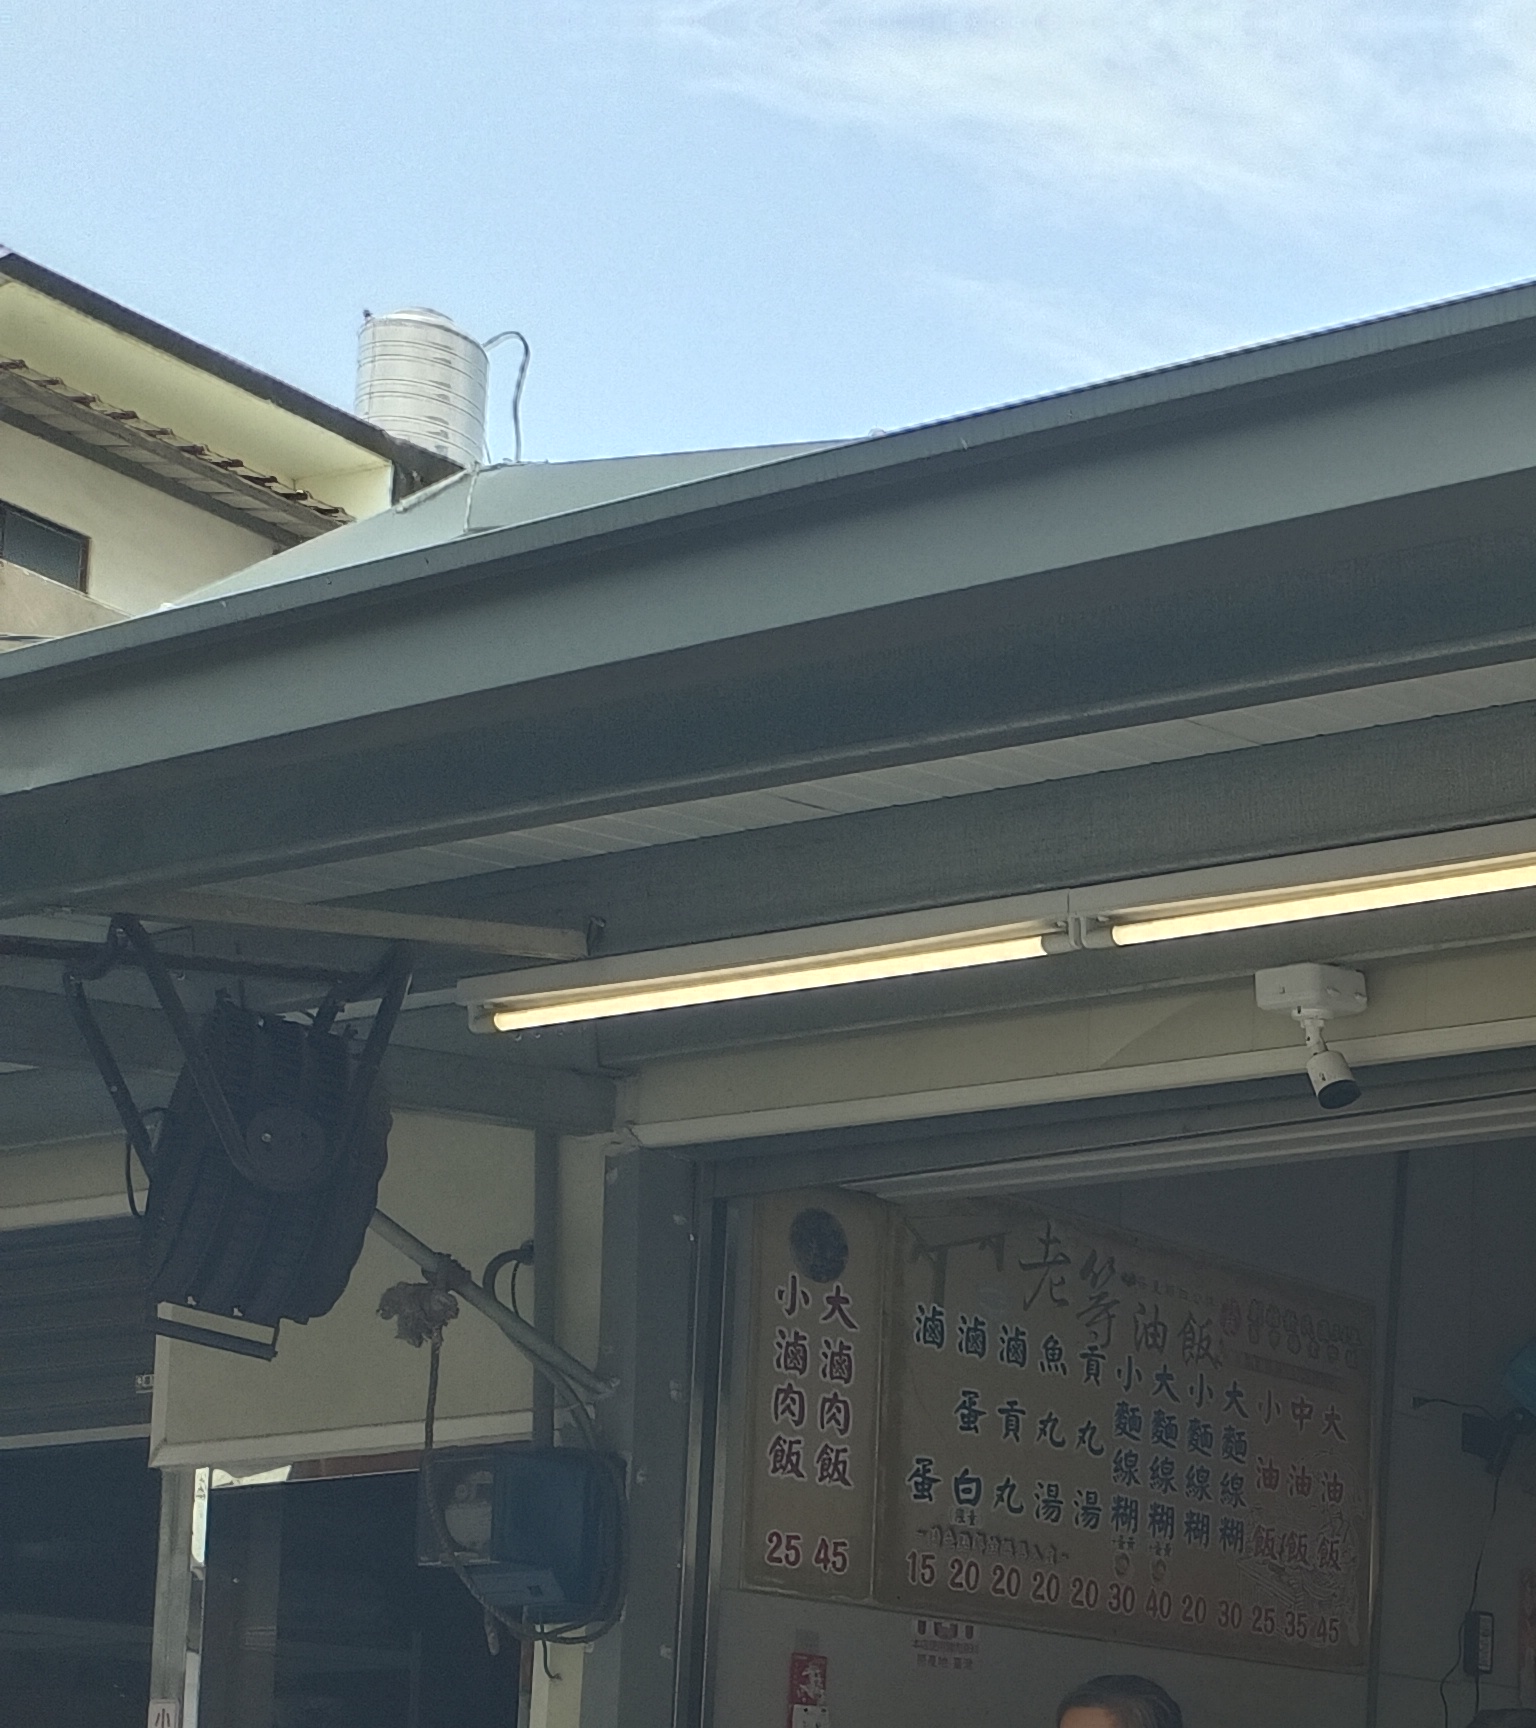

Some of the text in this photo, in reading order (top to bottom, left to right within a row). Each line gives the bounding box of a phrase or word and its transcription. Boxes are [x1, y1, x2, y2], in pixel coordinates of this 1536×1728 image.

[768, 1275, 809, 1480] 小滷肉飯
[815, 1284, 858, 1488] 大滷肉飯
[765, 1531, 848, 1574] 25 45
[906, 1551, 1340, 1646] 15 20 20 20 20 30 40 20 30 25 35 45
